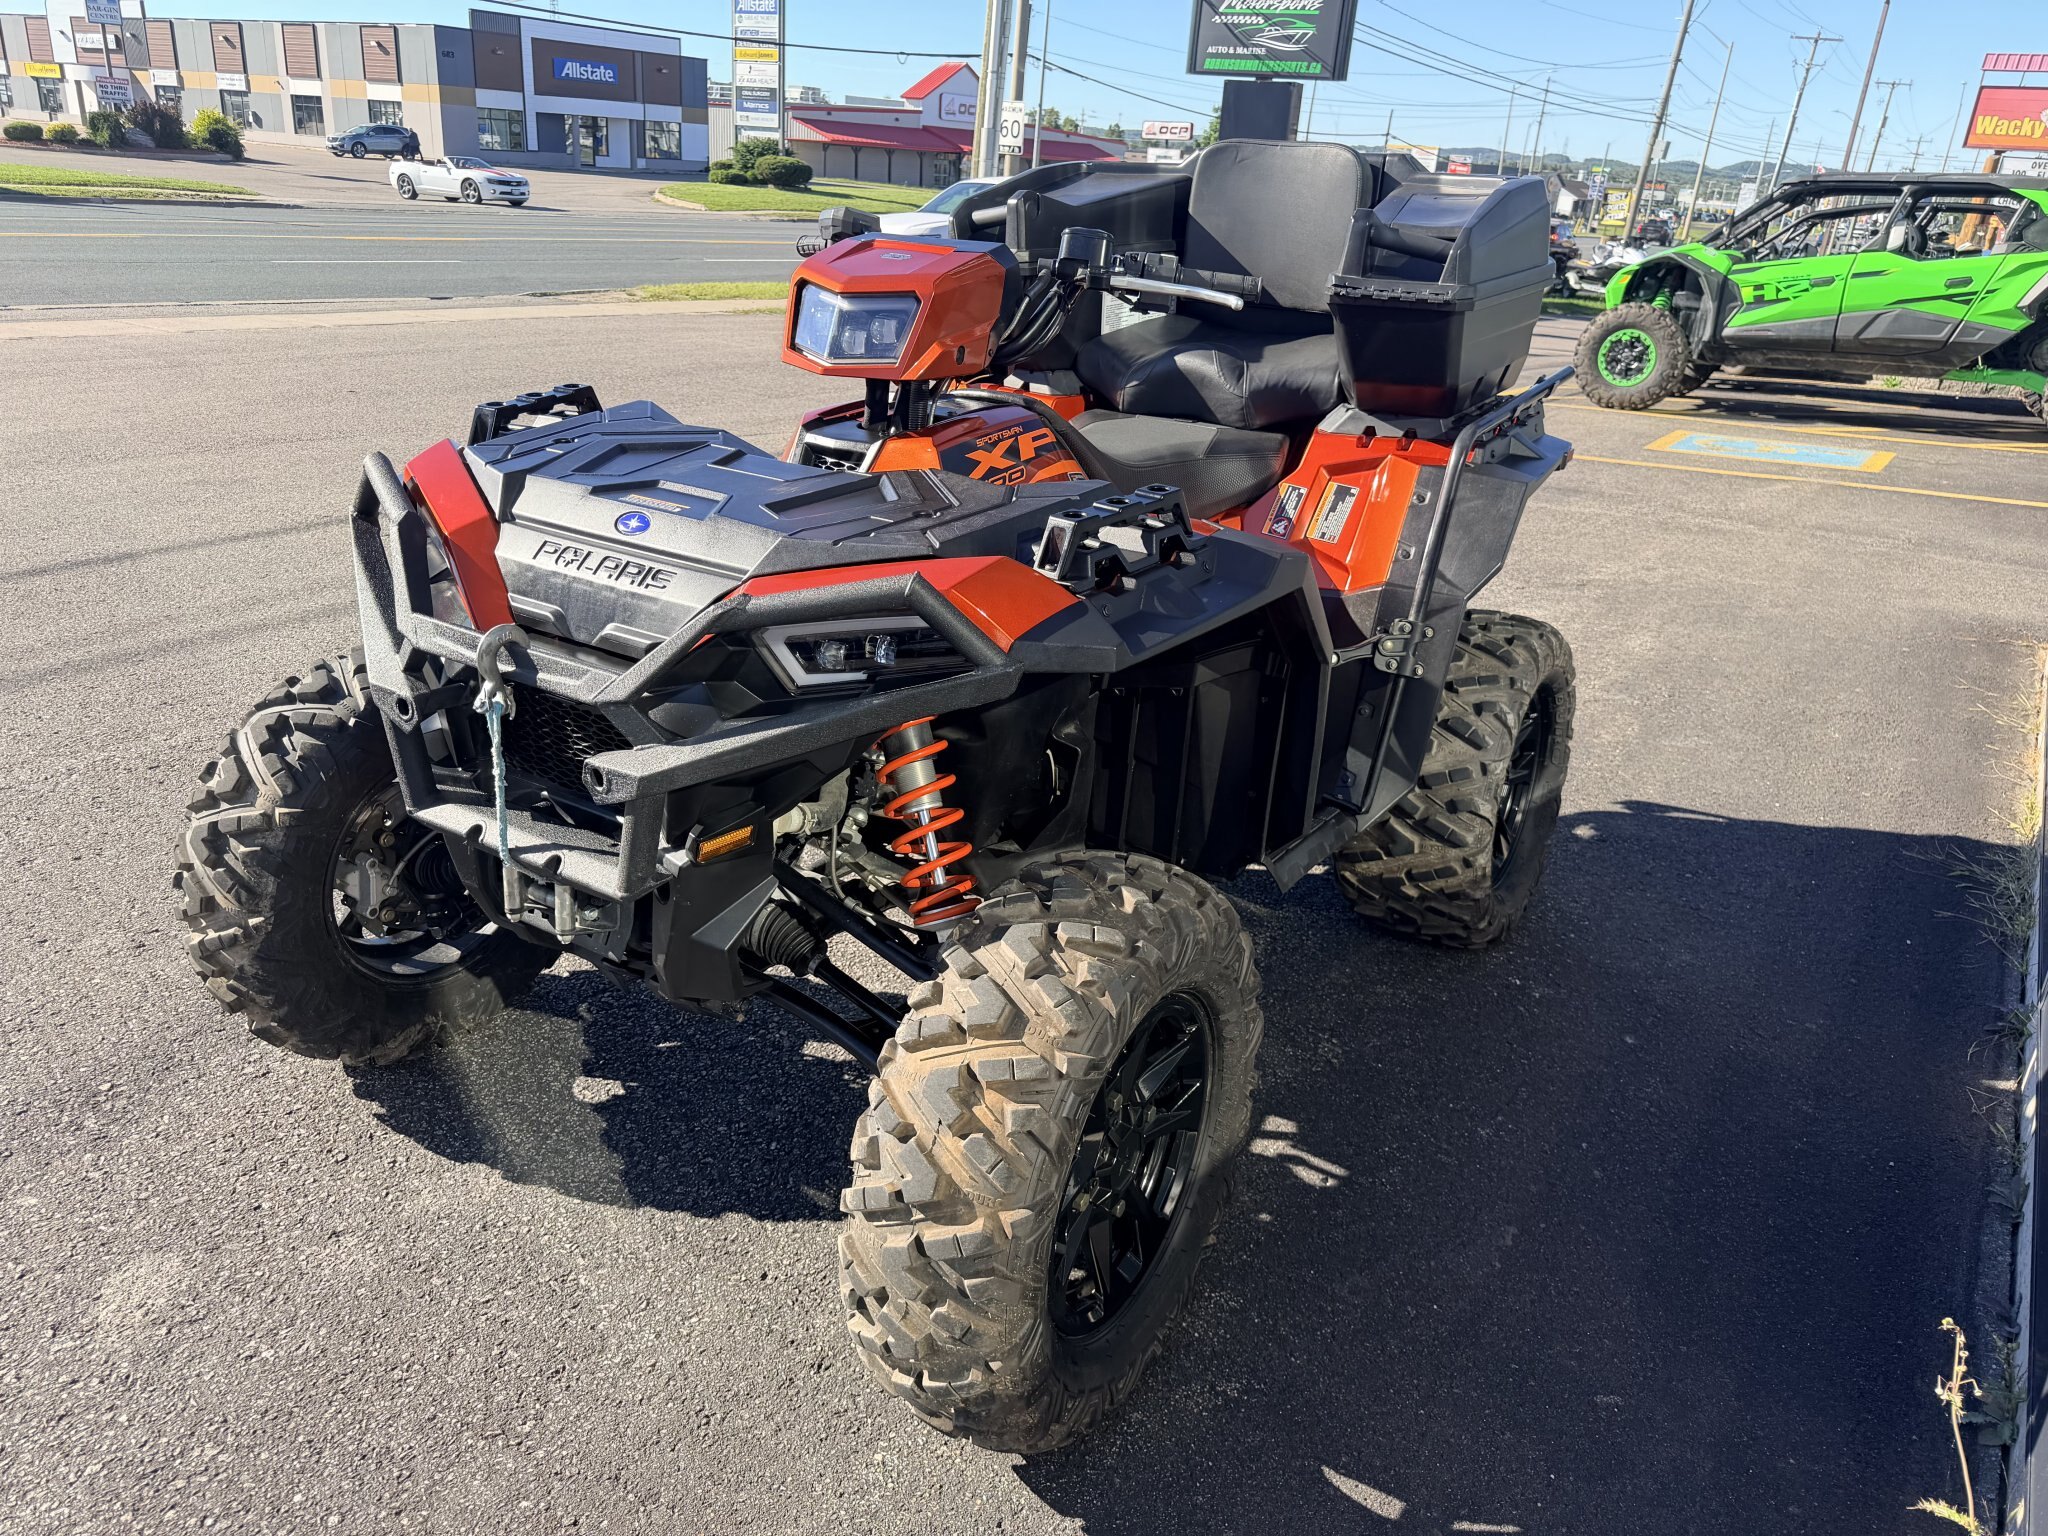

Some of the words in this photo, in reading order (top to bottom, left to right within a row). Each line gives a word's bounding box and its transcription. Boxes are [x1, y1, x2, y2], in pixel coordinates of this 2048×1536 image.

[737, 0, 776, 11] Allstate
[1206, 46, 1228, 54] AUTO
[1228, 46, 1235, 54] &
[1236, 47, 1266, 55] MARINE
[561, 61, 615, 82] Allstate
[1203, 58, 1322, 74] ROBINSONMOTORSPORTS.CA
[1000, 119, 1021, 138] 60
[1159, 126, 1189, 135] OCP
[1975, 115, 2046, 139] Wacky
[976, 426, 1023, 447] SPORTSMAN
[965, 427, 1057, 480] XP
[532, 540, 678, 590] POLARIS
